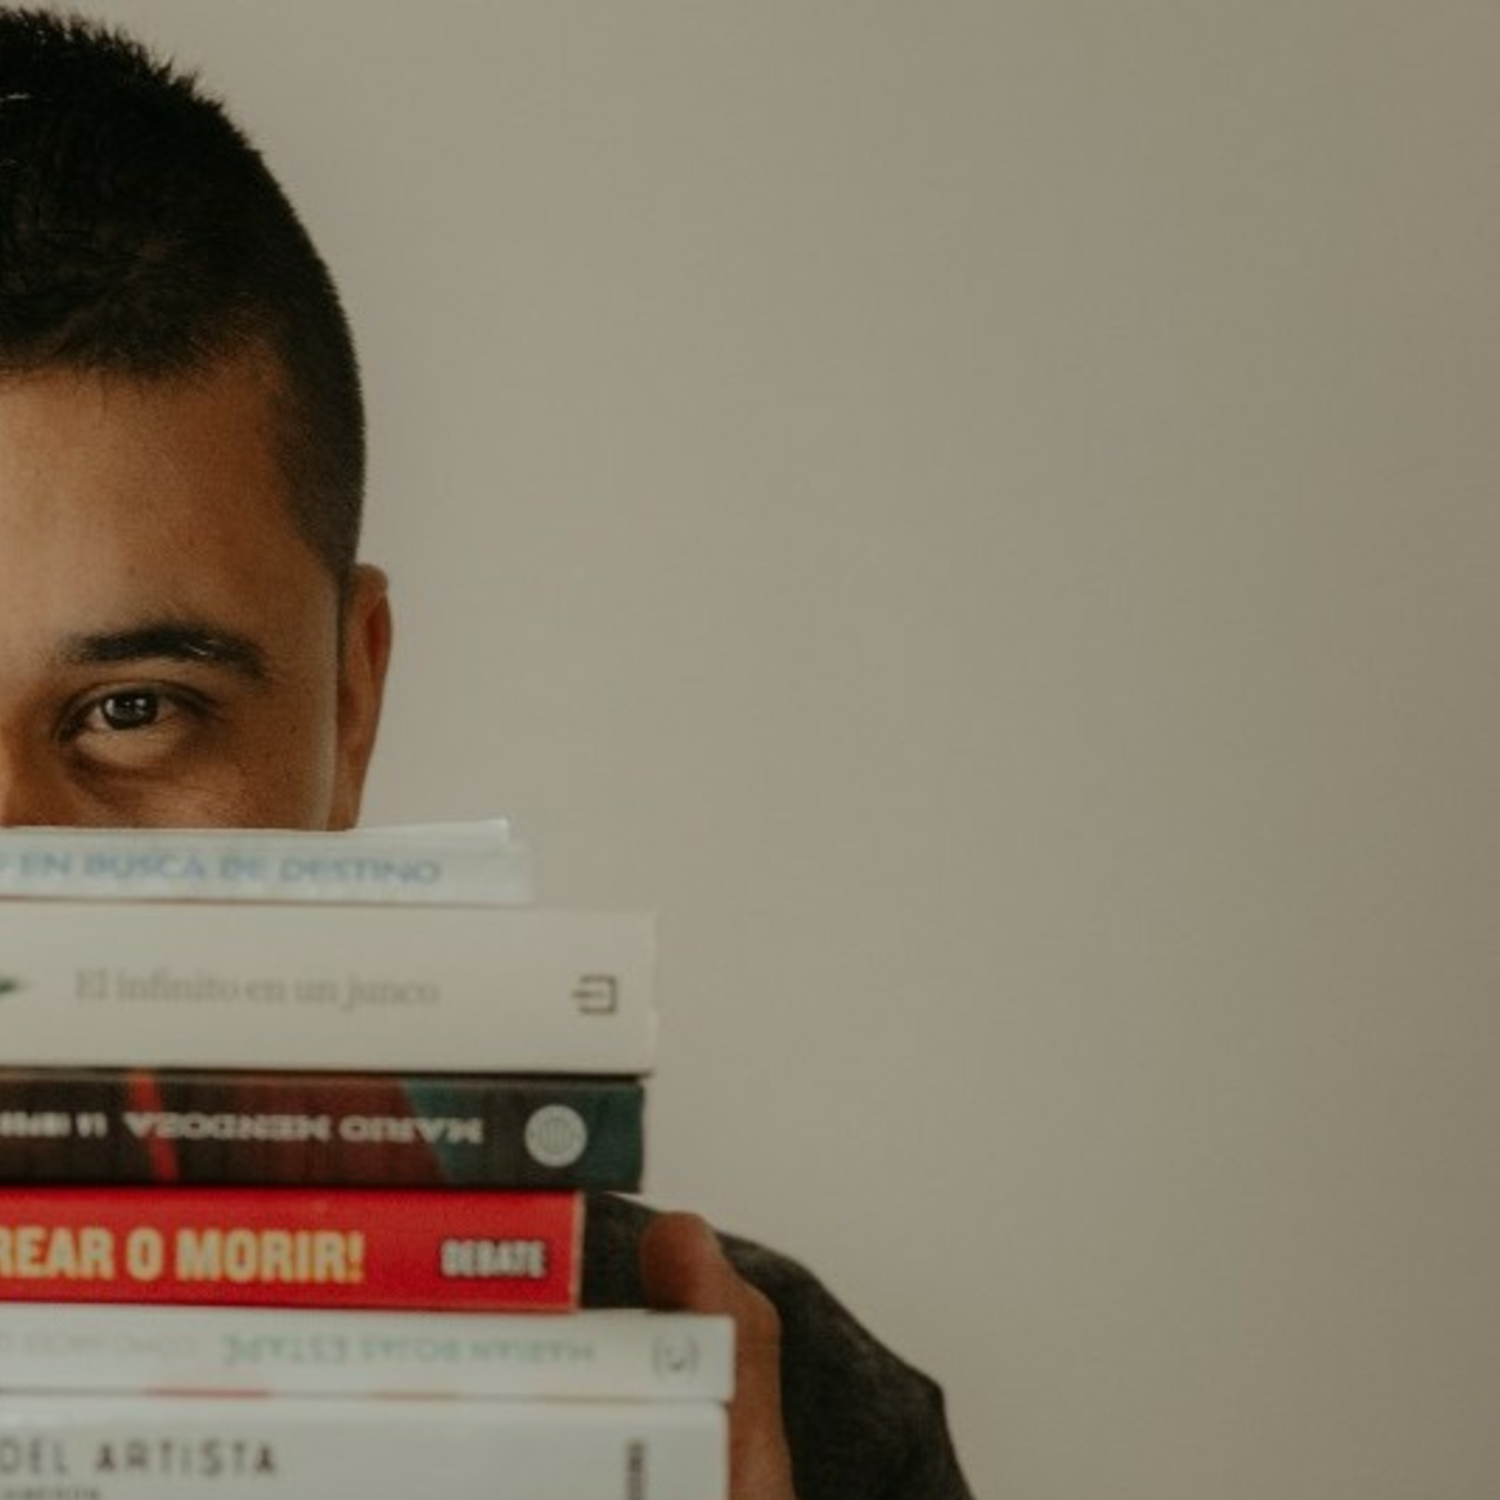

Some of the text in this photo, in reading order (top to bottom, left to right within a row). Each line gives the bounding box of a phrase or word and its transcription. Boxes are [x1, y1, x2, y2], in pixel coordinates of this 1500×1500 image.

[19, 853, 72, 876] EN
[84, 855, 207, 880] BUSCA
[219, 857, 267, 880] DE
[279, 859, 442, 885] DESTINO
[74, 969, 440, 1012] El infinito en un junco
[125, 1111, 483, 1144] MARIO MENDOZA
[126, 1226, 163, 1280] O
[175, 1228, 366, 1284] MORIR!
[440, 1239, 547, 1280] DEBATE
[363, 1335, 468, 1363] ROJAS
[477, 1337, 596, 1364] MARIAN
[96, 1438, 277, 1477] ARTISTA
